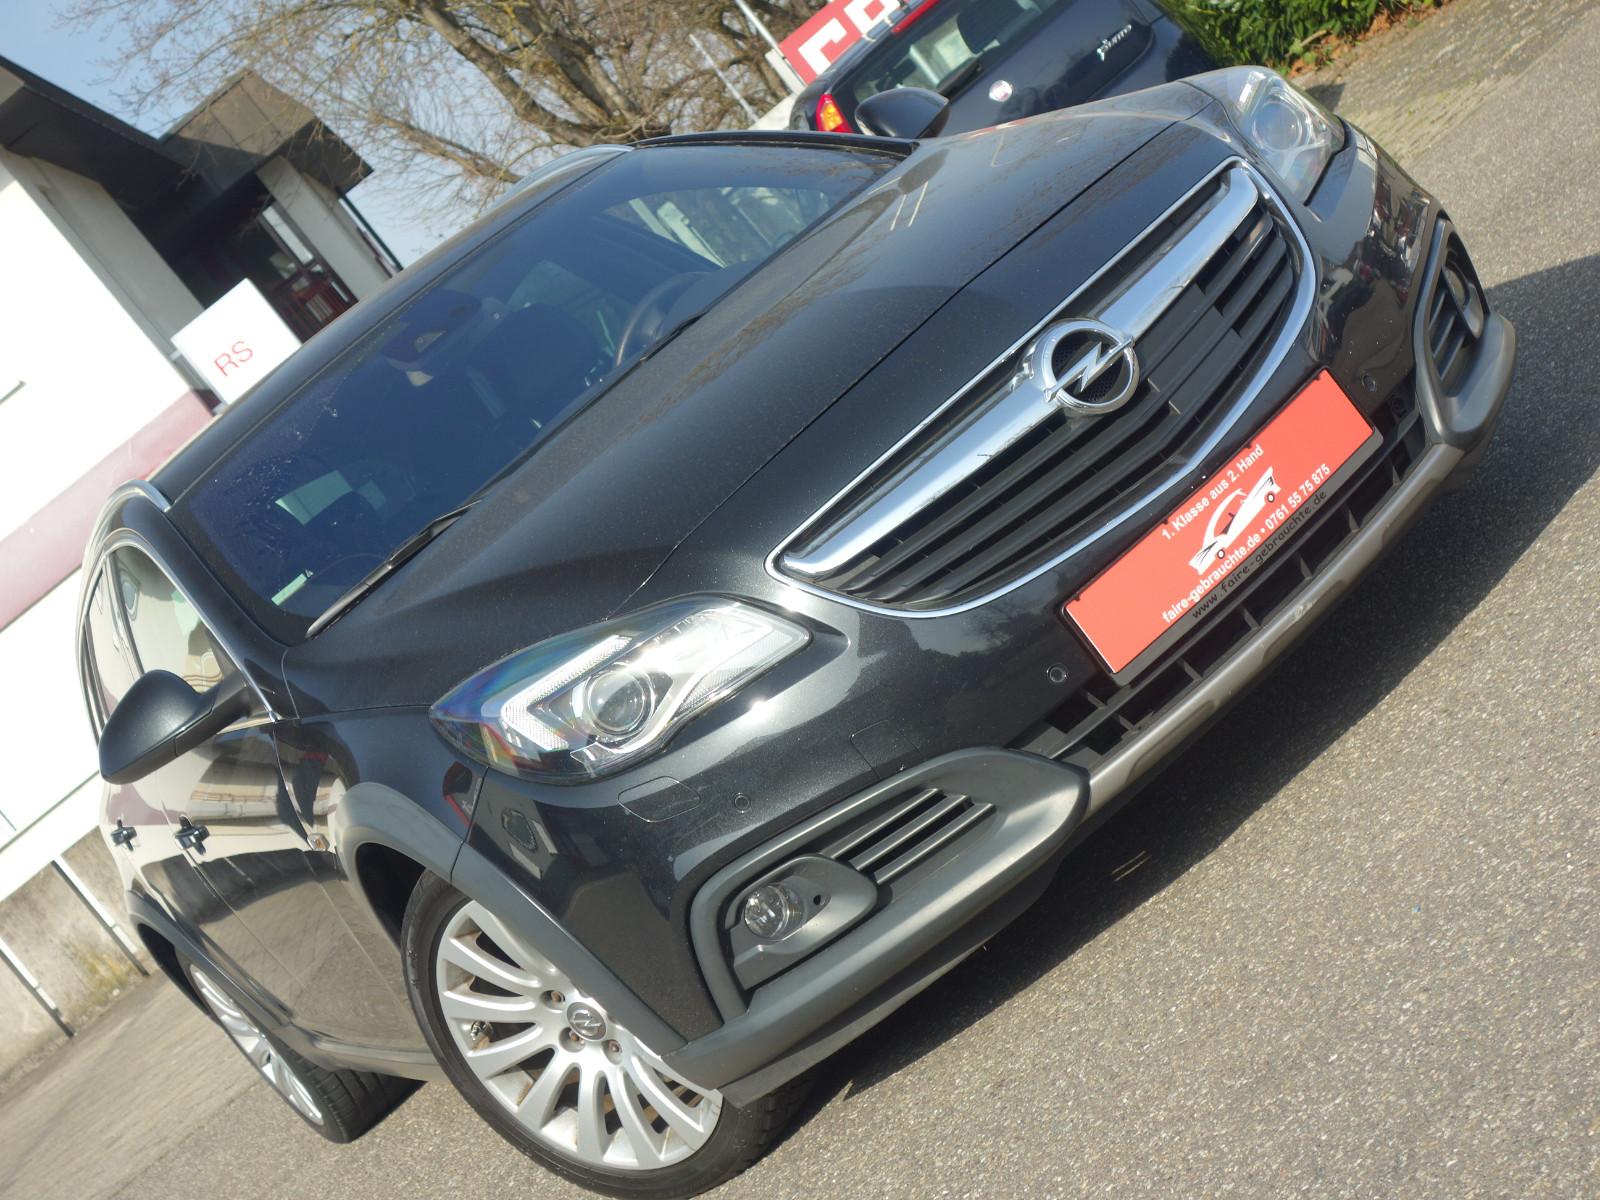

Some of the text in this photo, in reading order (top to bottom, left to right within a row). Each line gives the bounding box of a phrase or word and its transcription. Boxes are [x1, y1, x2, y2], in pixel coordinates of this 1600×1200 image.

[214, 340, 253, 377] RS
[1162, 444, 1264, 540] 1. Klasse aus 2. Hand
[1162, 463, 1331, 623] faire-gebrauchte.de 0761 55 75 875
